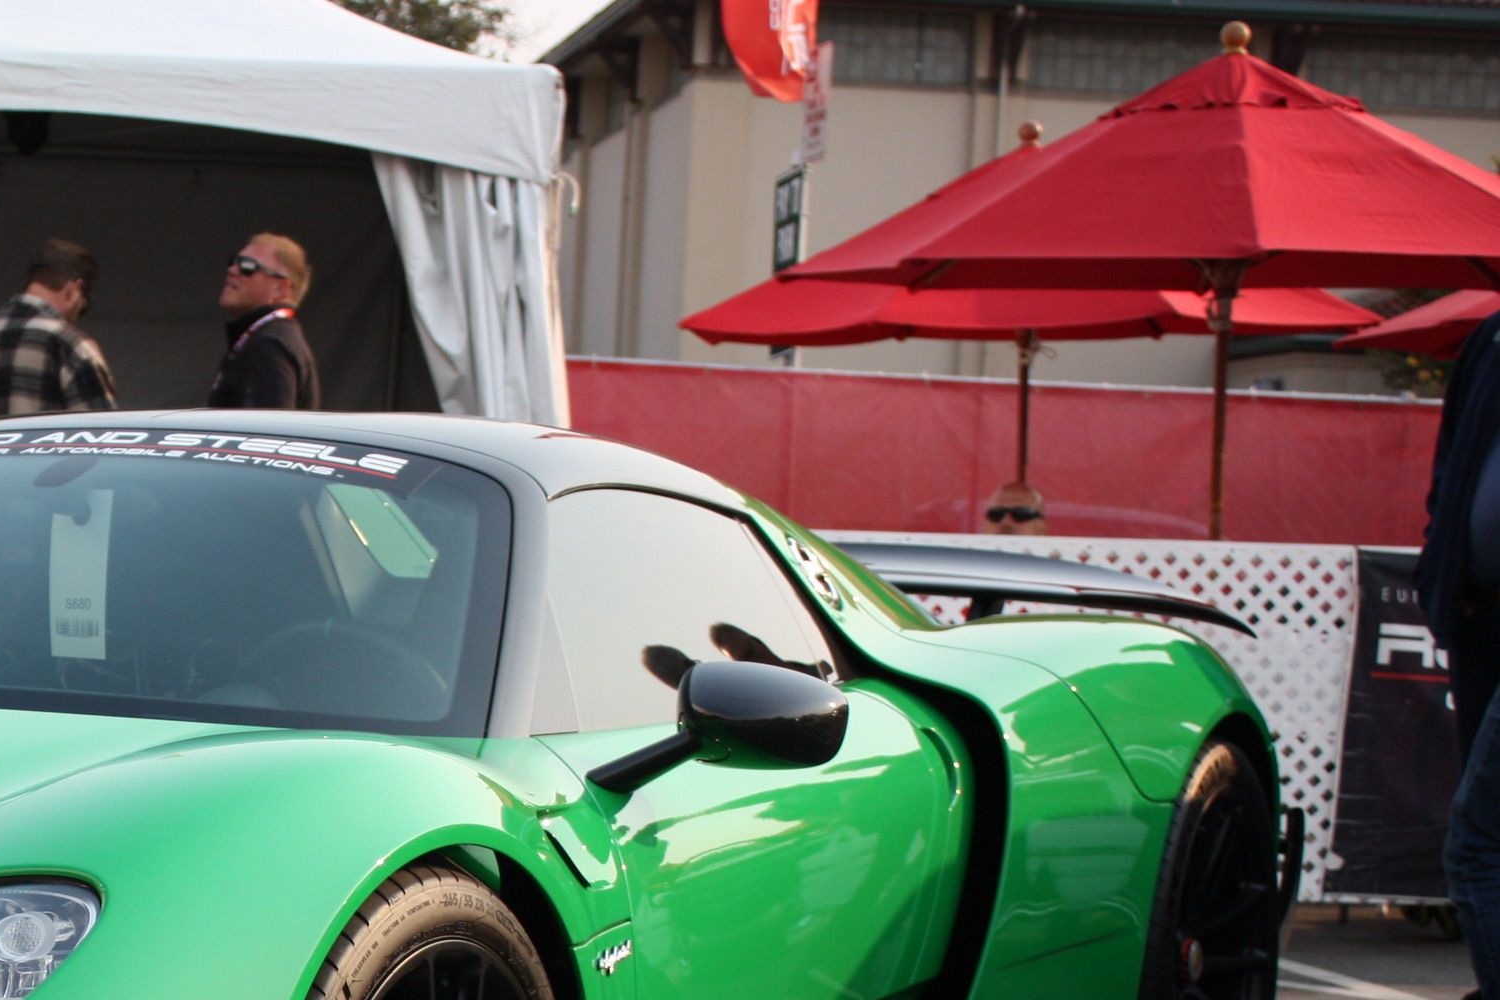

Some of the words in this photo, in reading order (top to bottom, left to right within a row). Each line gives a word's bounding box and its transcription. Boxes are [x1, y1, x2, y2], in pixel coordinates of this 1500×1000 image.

[20, 446, 186, 459] AUTOMOBILE
[192, 451, 336, 476] AUCTIONS
[30, 430, 148, 445] AND
[157, 432, 409, 475] STEELE
